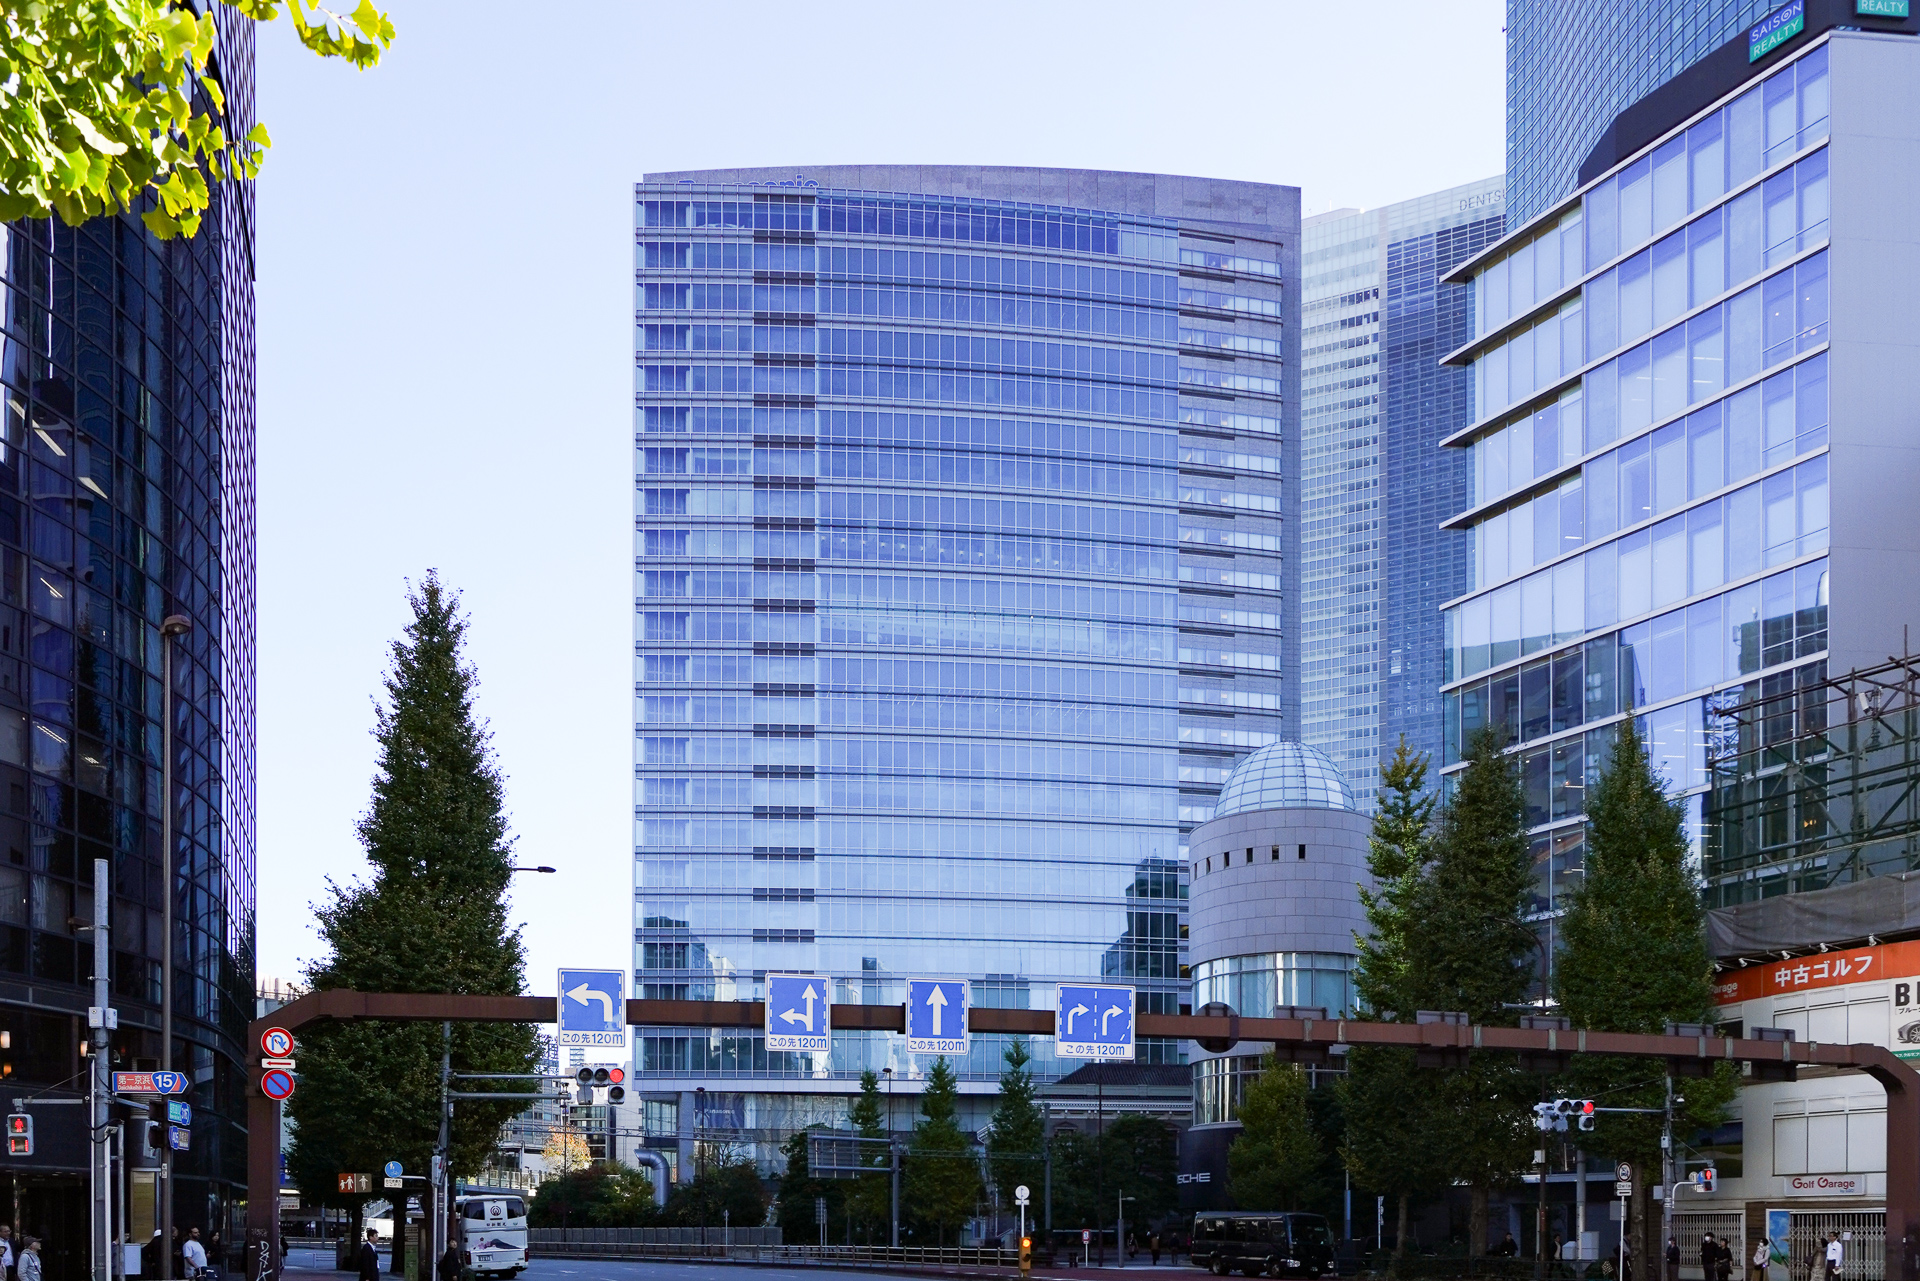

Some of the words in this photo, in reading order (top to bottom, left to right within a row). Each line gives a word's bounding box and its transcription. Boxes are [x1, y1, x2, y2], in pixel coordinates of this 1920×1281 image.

[1861, 0, 1905, 13] REALTY
[1751, 0, 1802, 42] SAISON
[1753, 19, 1799, 57] REALTY
[1774, 955, 1873, 987] 中古ゴルフ
[1898, 1007, 1920, 1015] ブルー
[562, 1033, 623, 1045] この先120m
[769, 1037, 827, 1049] この先120m
[909, 1040, 965, 1051] この先120m
[1065, 1044, 1125, 1056] この先120m
[118, 1075, 151, 1085] 第一京浜
[155, 1074, 173, 1088] 15
[1792, 1177, 1815, 1189] Golf
[1817, 1176, 1855, 1190] Garage
